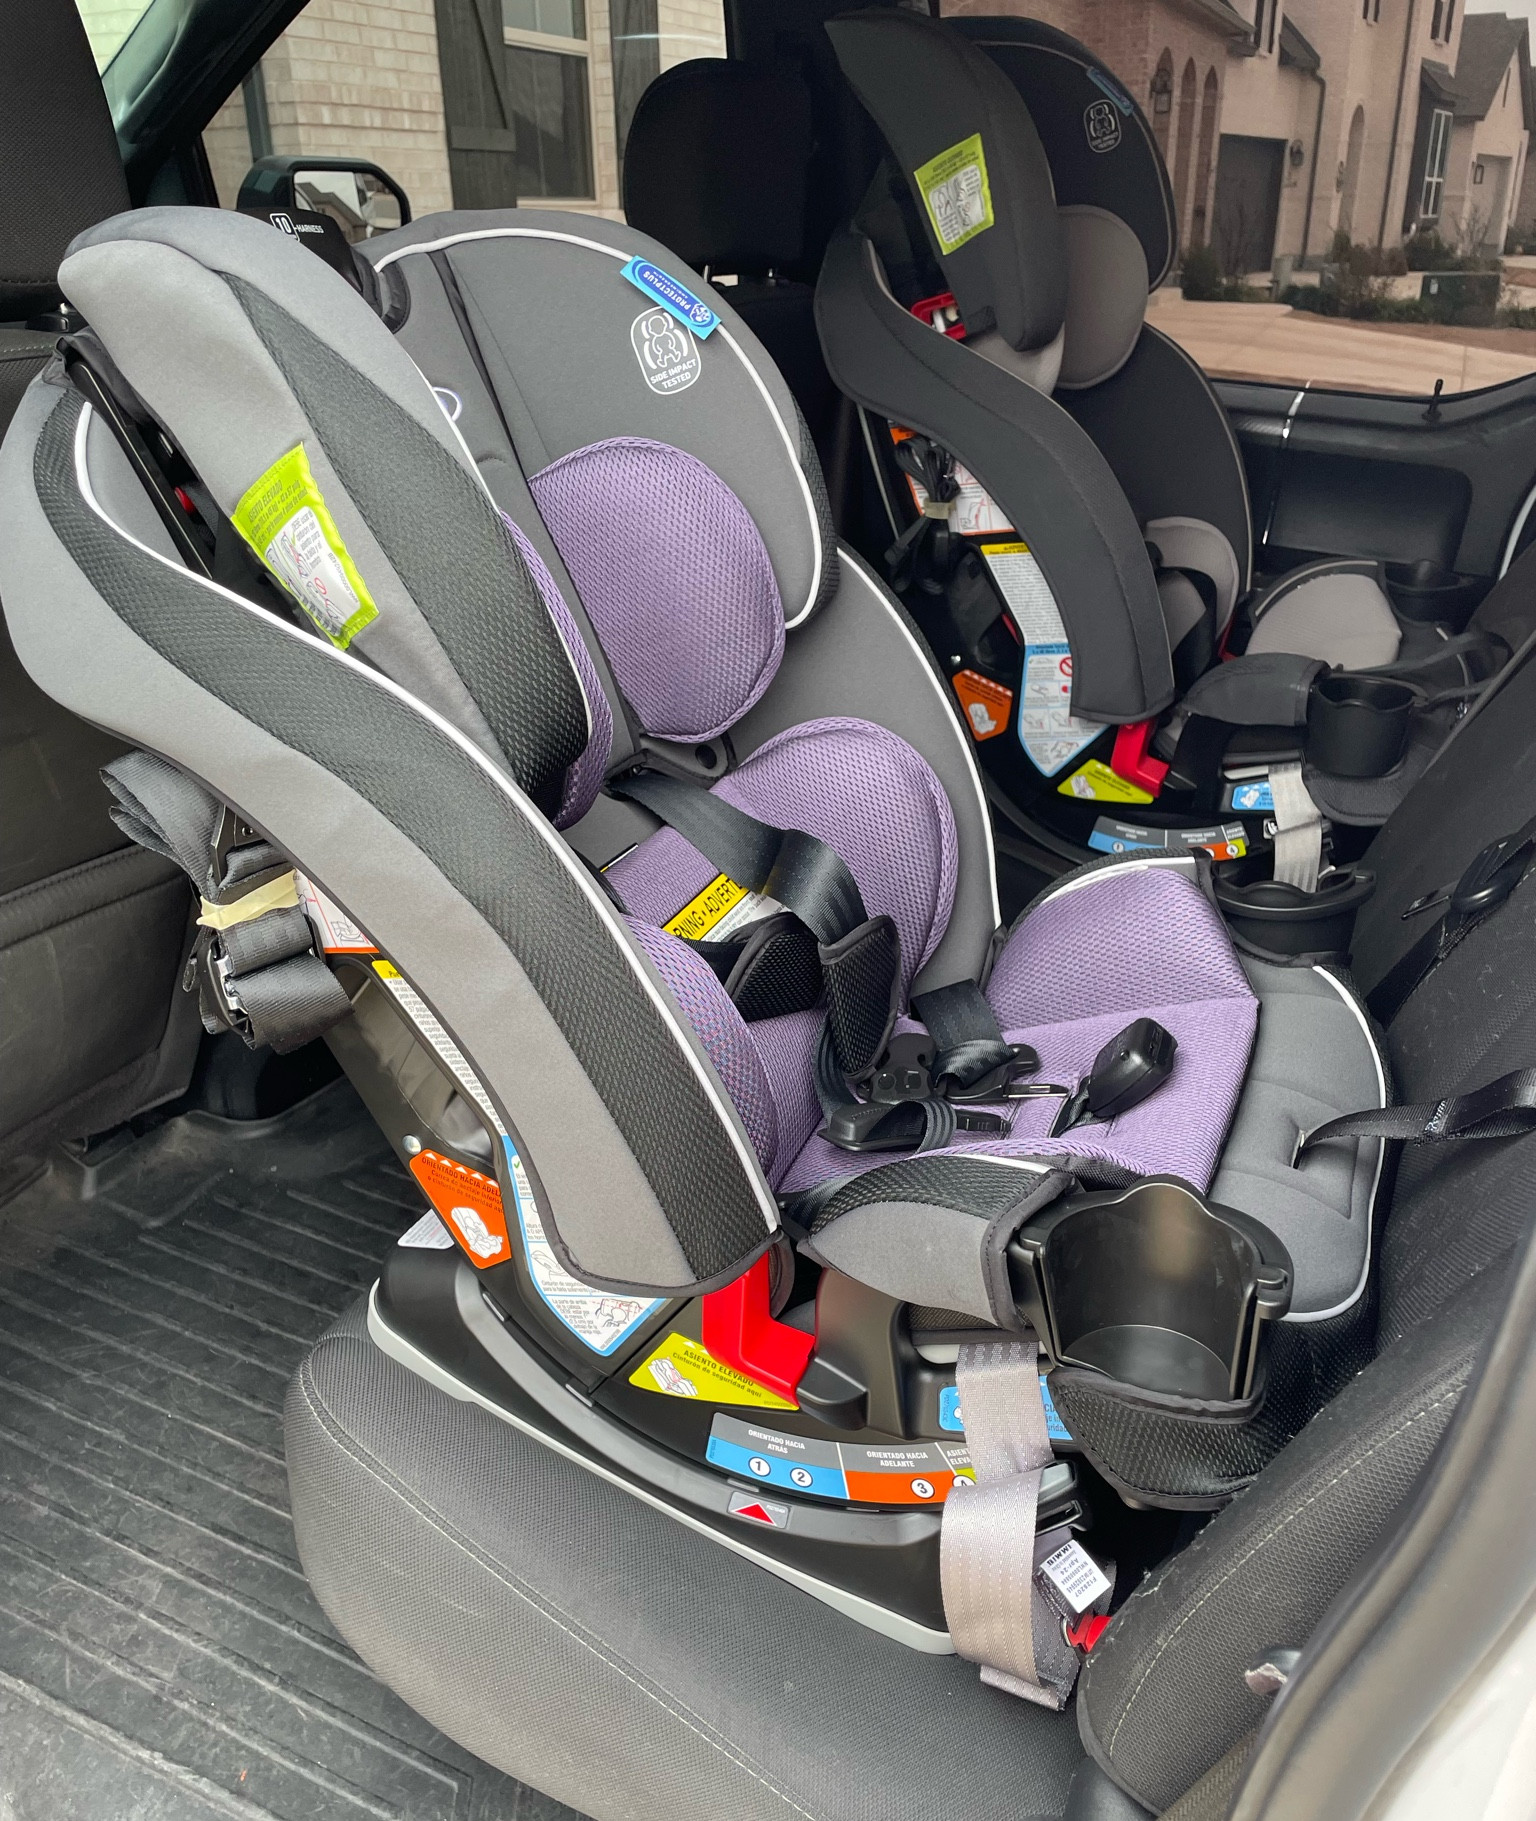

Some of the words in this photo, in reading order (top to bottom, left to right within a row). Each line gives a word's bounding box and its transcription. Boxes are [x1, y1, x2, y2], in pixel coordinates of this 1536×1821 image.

[276, 217, 292, 233] 10
[643, 271, 691, 310] PROTECTPLUS
[650, 373, 669, 384] SIDE
[668, 359, 697, 376] IMPACT
[662, 371, 691, 389] TESTED
[421, 1157, 458, 1179] ORIENTADO
[460, 1174, 481, 1188] HACIA
[672, 1352, 701, 1369] Cinturón
[702, 1366, 711, 1374] de
[712, 1371, 745, 1390] seguridad
[746, 1387, 762, 1398] aquí
[683, 1350, 717, 1369] ASIENTO
[719, 1366, 754, 1387] ELEVADO
[748, 1429, 784, 1445] ORIENTADO
[785, 1439, 805, 1450] HACIA
[767, 1443, 788, 1454] ATRÁS
[866, 1450, 906, 1459] ORIENTADO
[906, 1451, 928, 1459] HACIA
[755, 1461, 761, 1471] 1
[797, 1471, 806, 1483] 2
[917, 1482, 928, 1494] 3
[1060, 1558, 1079, 1575] Apr-24
